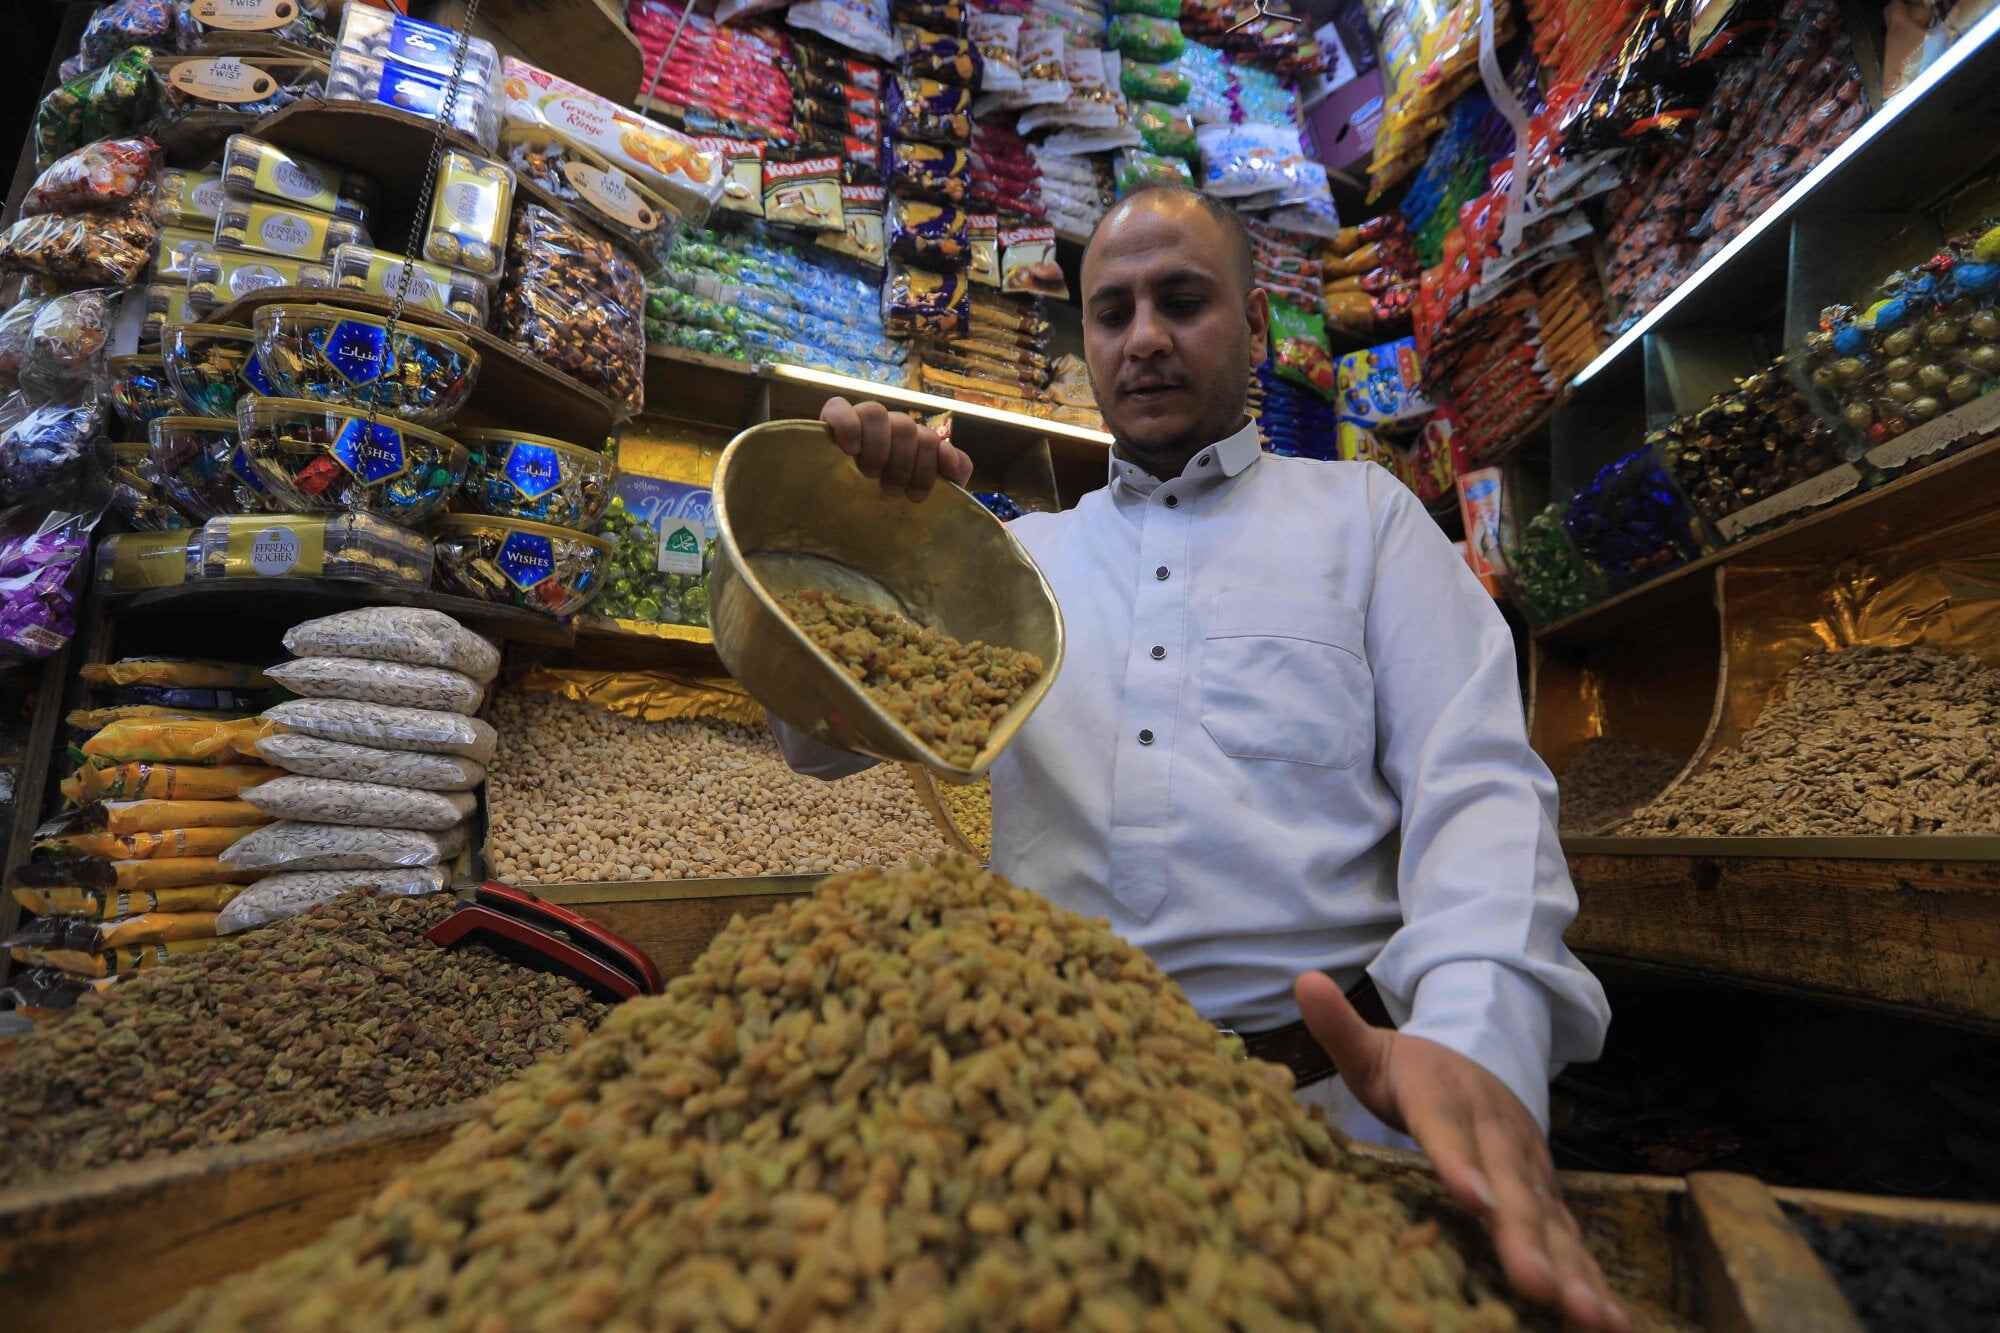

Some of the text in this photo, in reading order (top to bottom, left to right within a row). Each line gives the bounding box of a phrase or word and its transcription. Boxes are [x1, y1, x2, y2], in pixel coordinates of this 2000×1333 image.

[767, 158, 839, 177] KOPIKO
[255, 543, 295, 552] FERRERO
[254, 551, 294, 562] ROCHER
[506, 550, 550, 568] WISHES
